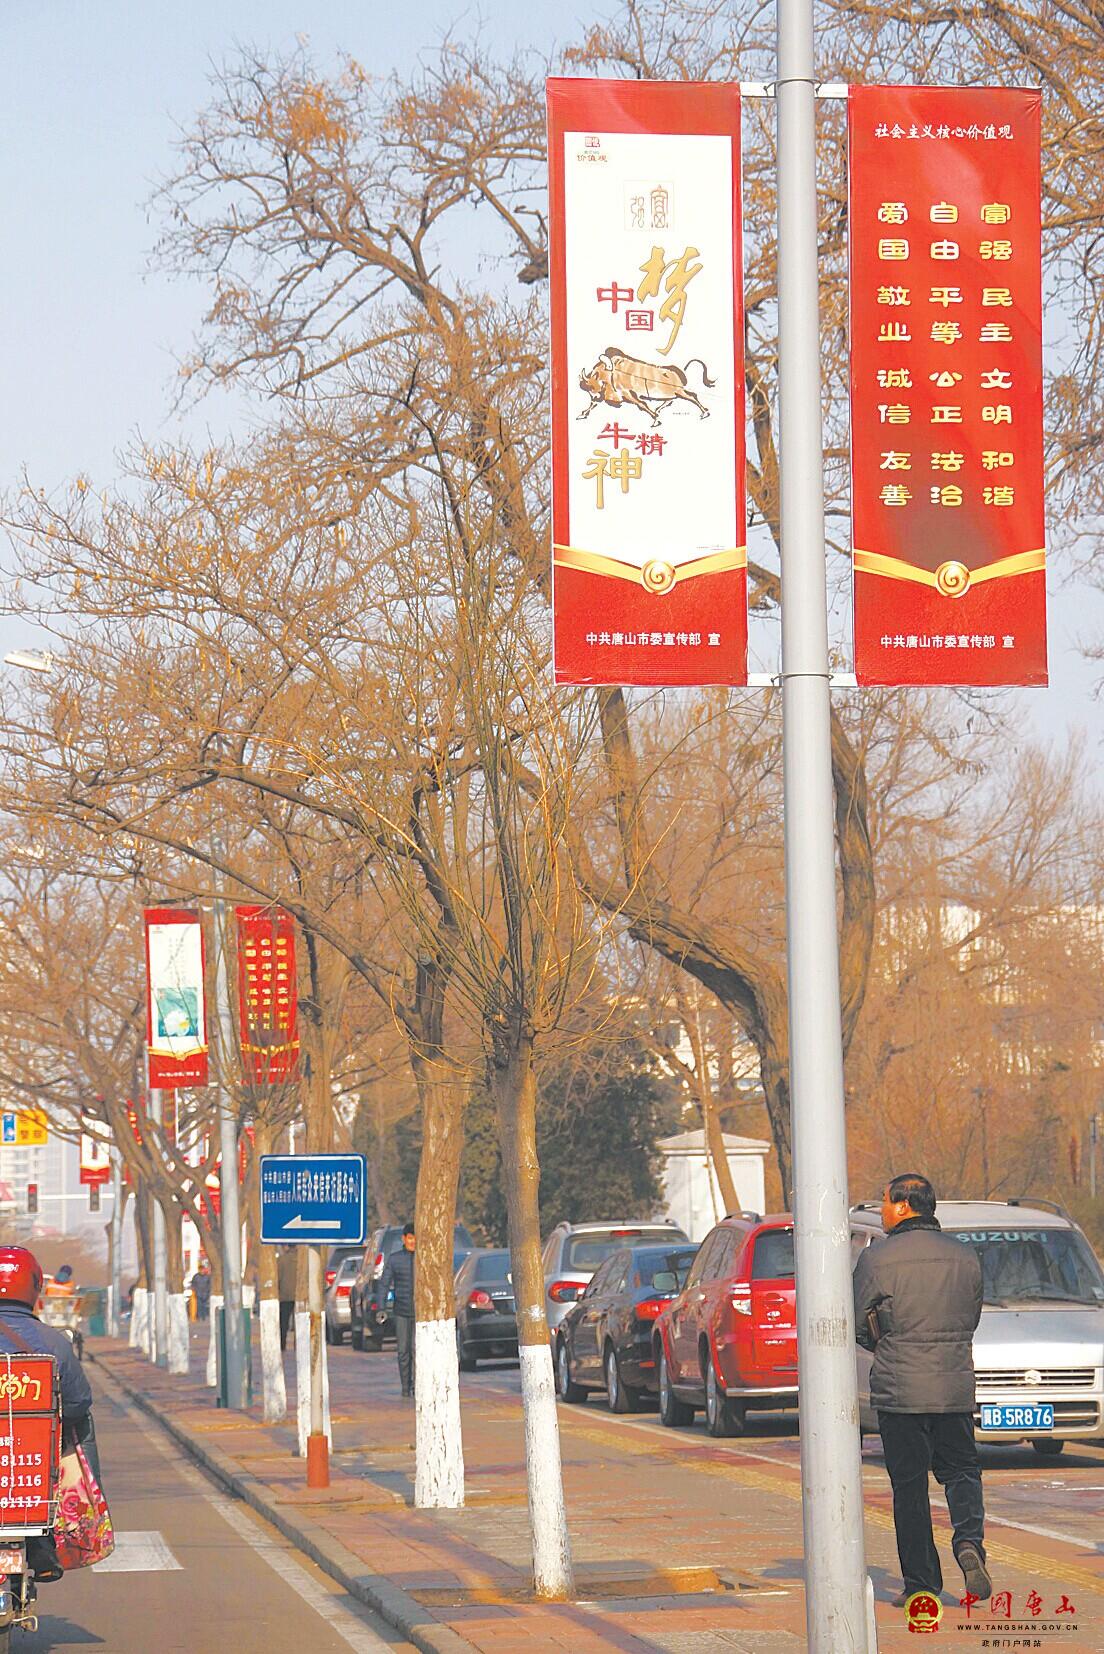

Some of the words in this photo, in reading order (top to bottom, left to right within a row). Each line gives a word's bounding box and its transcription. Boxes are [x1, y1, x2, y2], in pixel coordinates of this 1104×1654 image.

[874, 124, 1013, 140] 社会主义核心价值观
[586, 632, 702, 647] 中共唐山市委宣传部
[880, 635, 996, 649] 中共唐山市委宣传部
[956, 1231, 1048, 1243] SUZUKI
